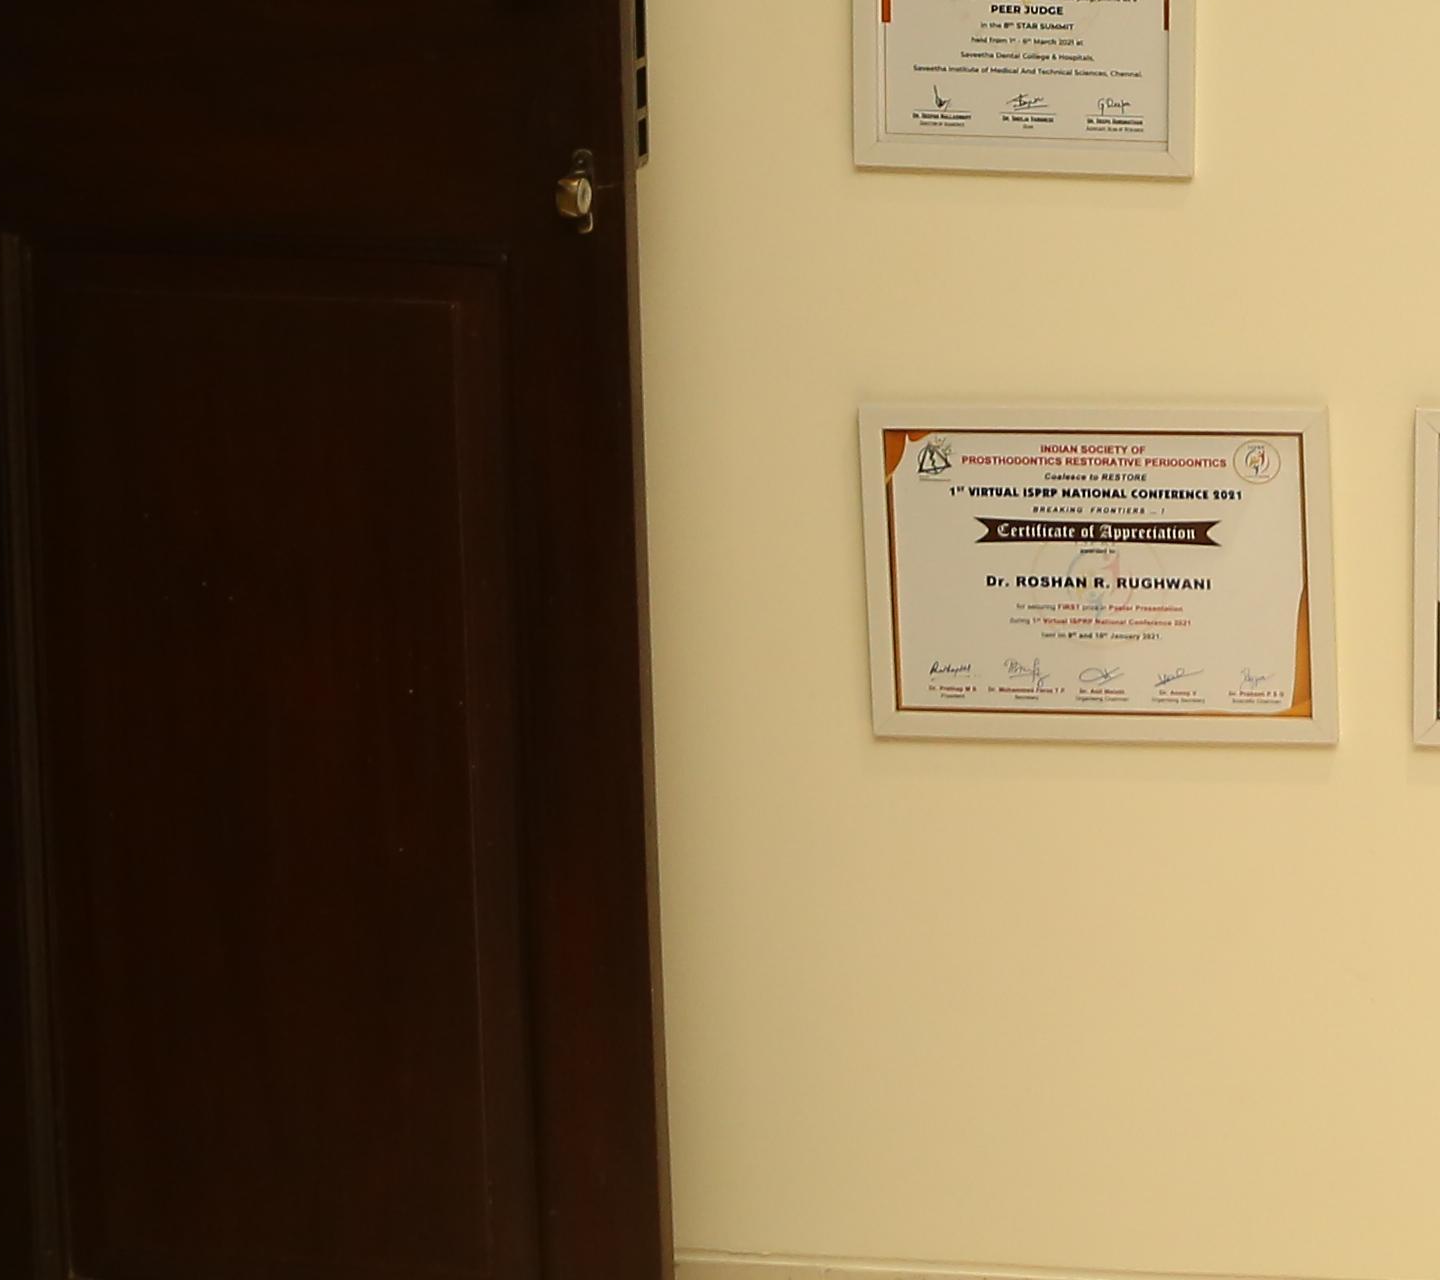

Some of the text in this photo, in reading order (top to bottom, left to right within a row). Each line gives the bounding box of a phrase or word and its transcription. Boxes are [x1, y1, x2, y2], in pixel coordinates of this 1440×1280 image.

[991, 4, 1063, 15] PEER JUDGE
[1040, 445, 1145, 454] INDIAN SOCIETY OF
[961, 457, 1227, 468] PROSTHODONTICS RESTORATIVE PERIODONTICS
[968, 488, 1018, 498] VIRTUAL
[1023, 488, 1058, 498] ISPRP
[1061, 489, 1126, 499] NATIONAL
[1131, 490, 1208, 500] CONFERENCE
[1213, 491, 1242, 500] 2021
[997, 523, 1196, 542] Certificate of Appreciation
[986, 576, 1211, 591] Dr. ROSHAN R. RUGHWANI
